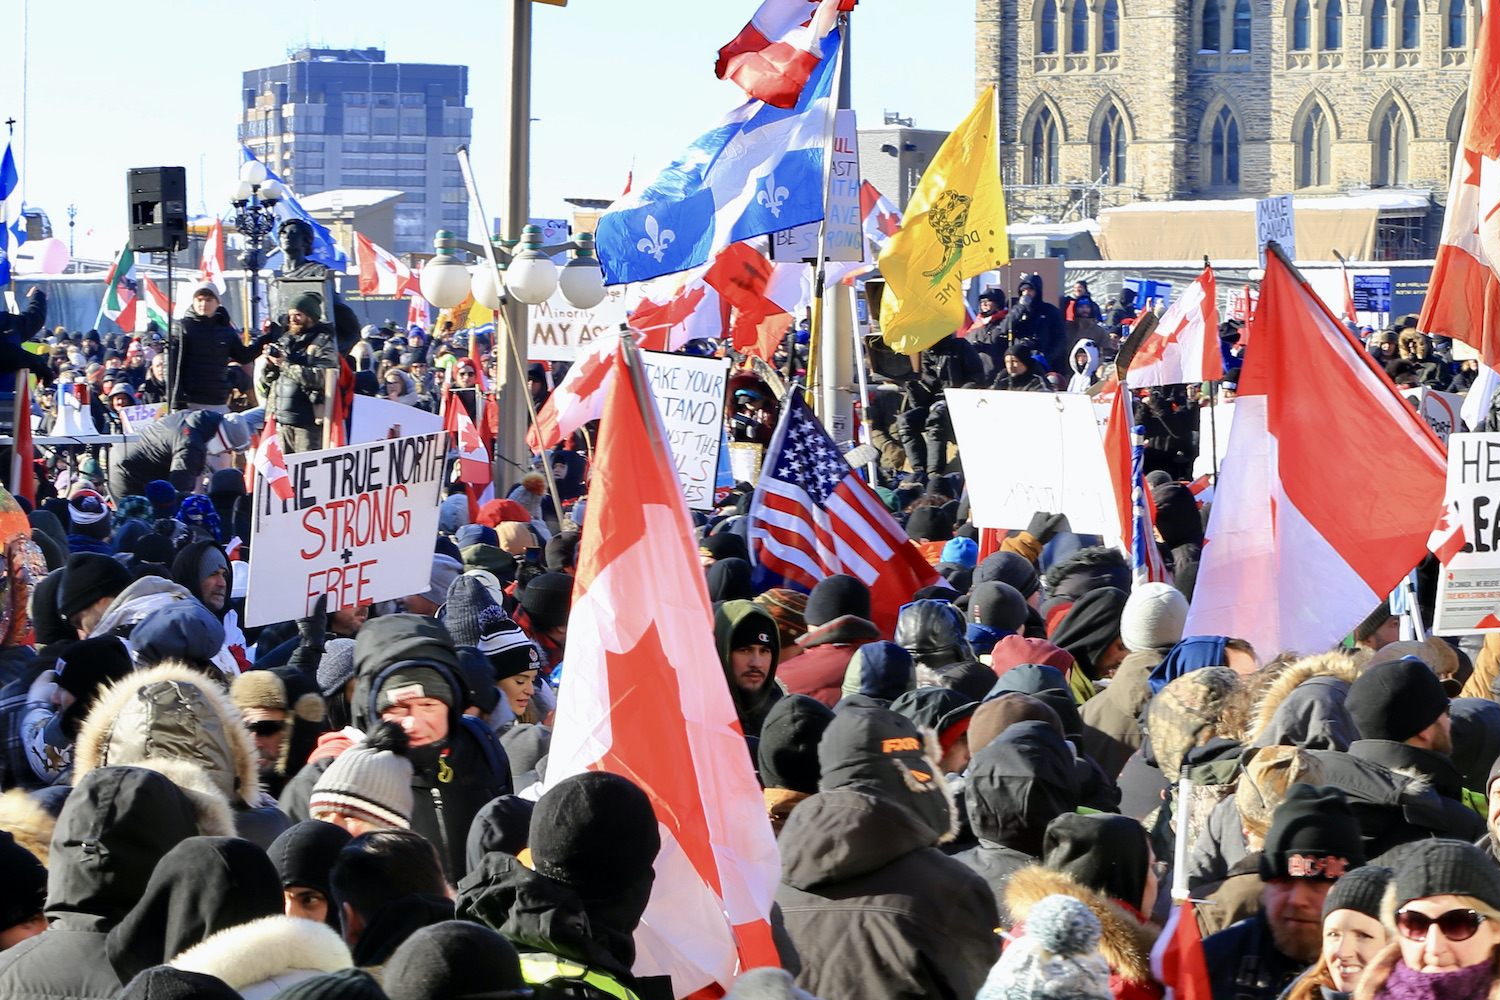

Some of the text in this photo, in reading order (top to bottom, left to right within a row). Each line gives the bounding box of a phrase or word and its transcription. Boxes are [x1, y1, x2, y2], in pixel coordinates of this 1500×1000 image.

[1260, 196, 1288, 221] MAKE
[534, 302, 596, 323] Minority
[532, 322, 570, 346] MY
[644, 364, 723, 399] TAKE YOUR
[653, 396, 718, 426] TAND
[695, 433, 720, 457] THE
[322, 446, 385, 500] TRUE
[388, 432, 450, 507] NORTH
[300, 484, 412, 561] STRONG
[305, 559, 378, 618] FREE
